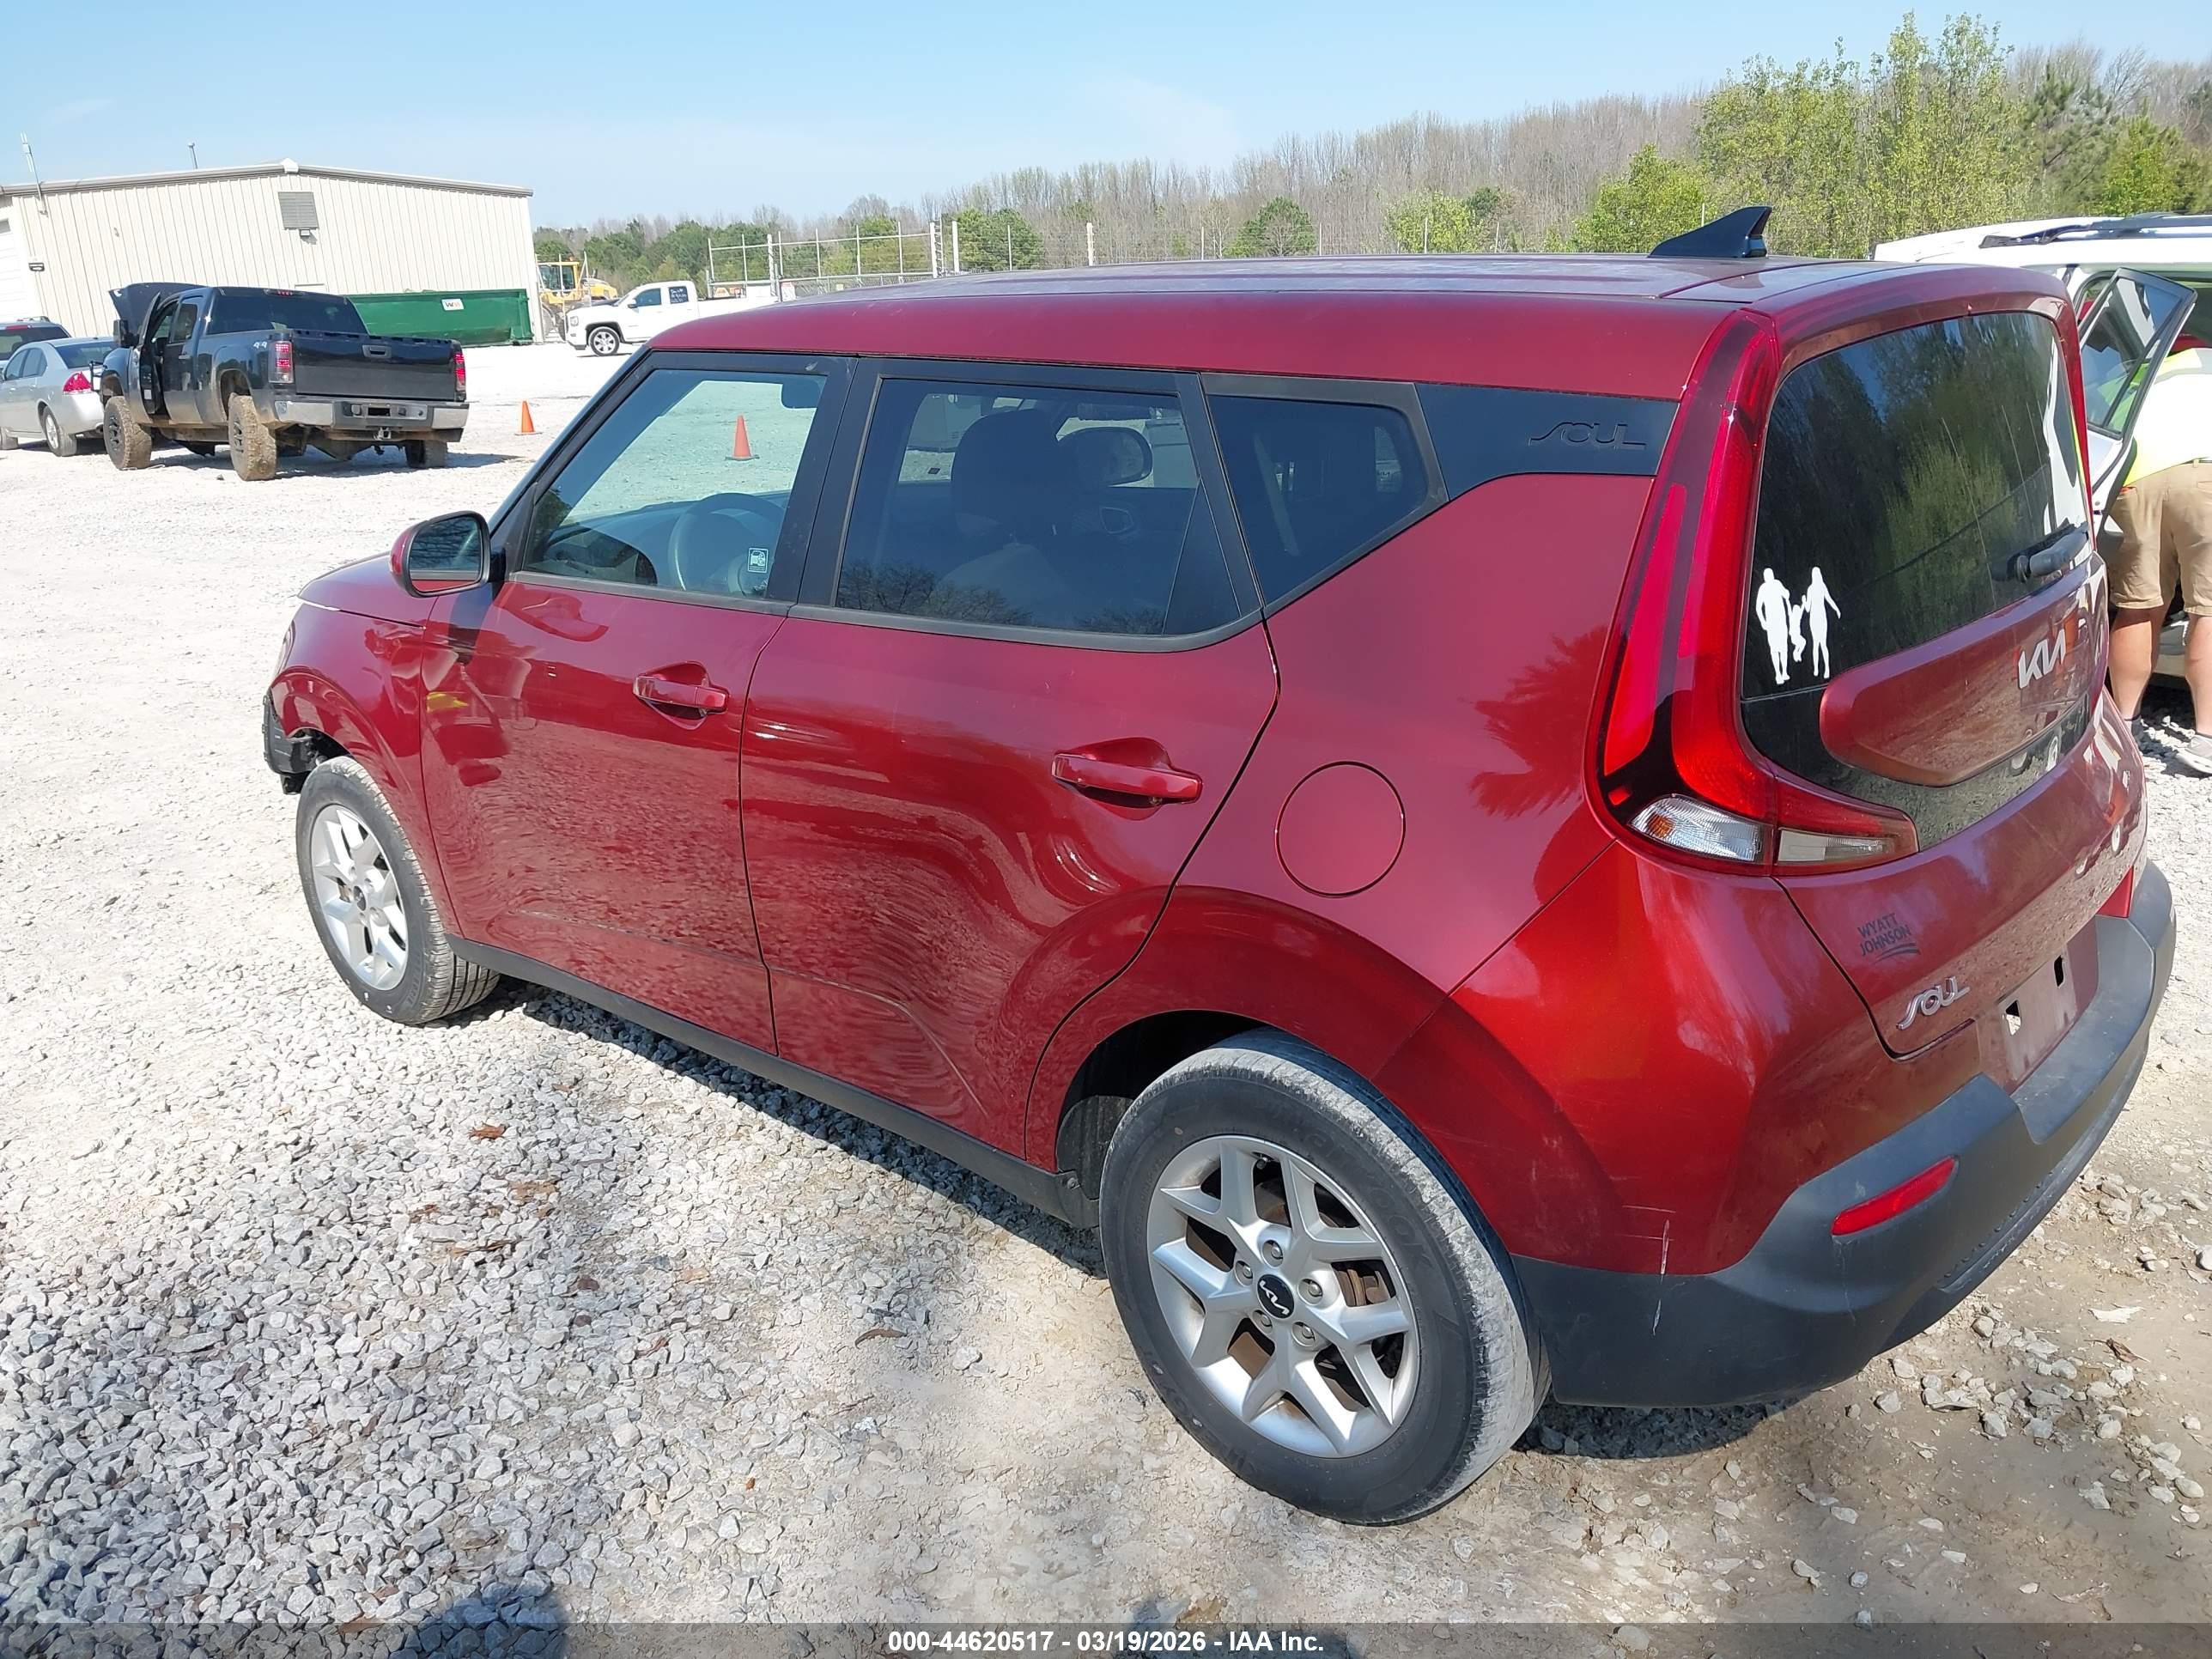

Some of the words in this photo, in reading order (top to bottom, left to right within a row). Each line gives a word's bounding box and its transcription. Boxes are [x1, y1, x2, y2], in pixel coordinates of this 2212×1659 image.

[2018, 628, 2066, 690] KIA
[1857, 913, 1898, 938] WYATT
[1859, 924, 1912, 957] JOHNSON
